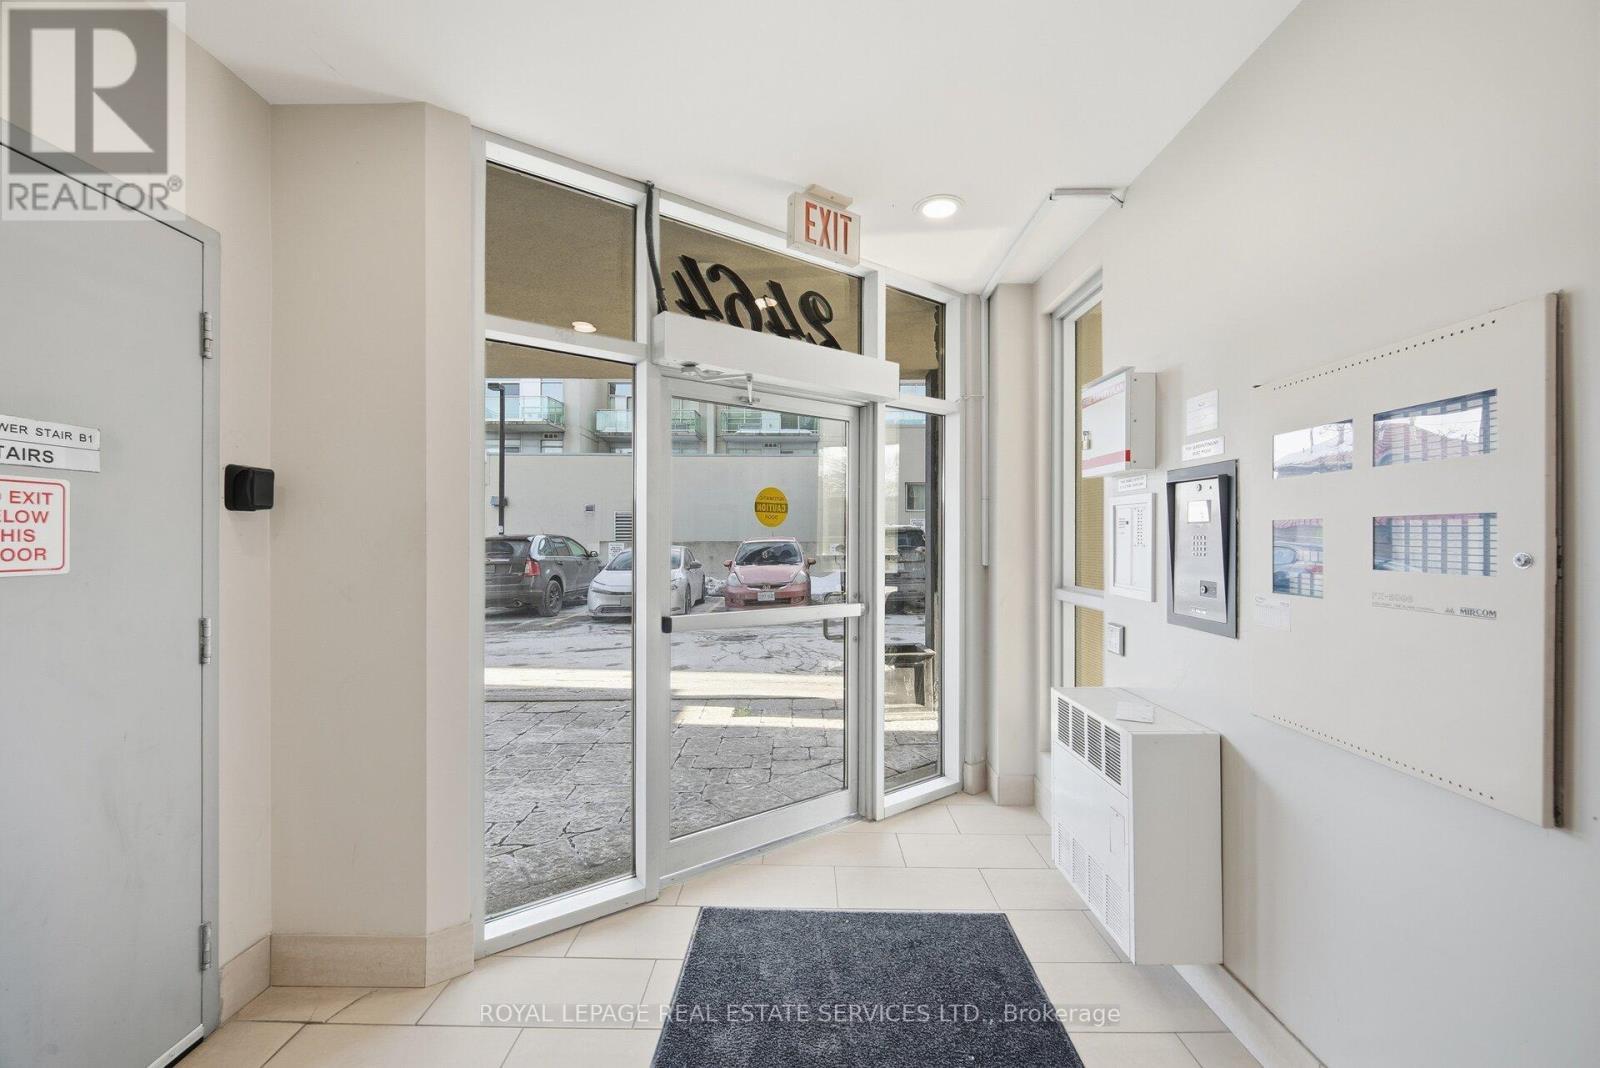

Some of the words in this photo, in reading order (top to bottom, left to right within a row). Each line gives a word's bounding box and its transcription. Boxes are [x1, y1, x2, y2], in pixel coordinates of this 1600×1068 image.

[804, 200, 853, 255] EXIT
[0, 422, 28, 435] WER
[35, 427, 73, 440] STAIR
[79, 433, 93, 443] B1
[10, 490, 53, 505] EXIT
[0, 509, 49, 523] LOW
[0, 529, 36, 542] HIS
[0, 548, 47, 561] OOR
[1459, 606, 1497, 619] MIRCOM
